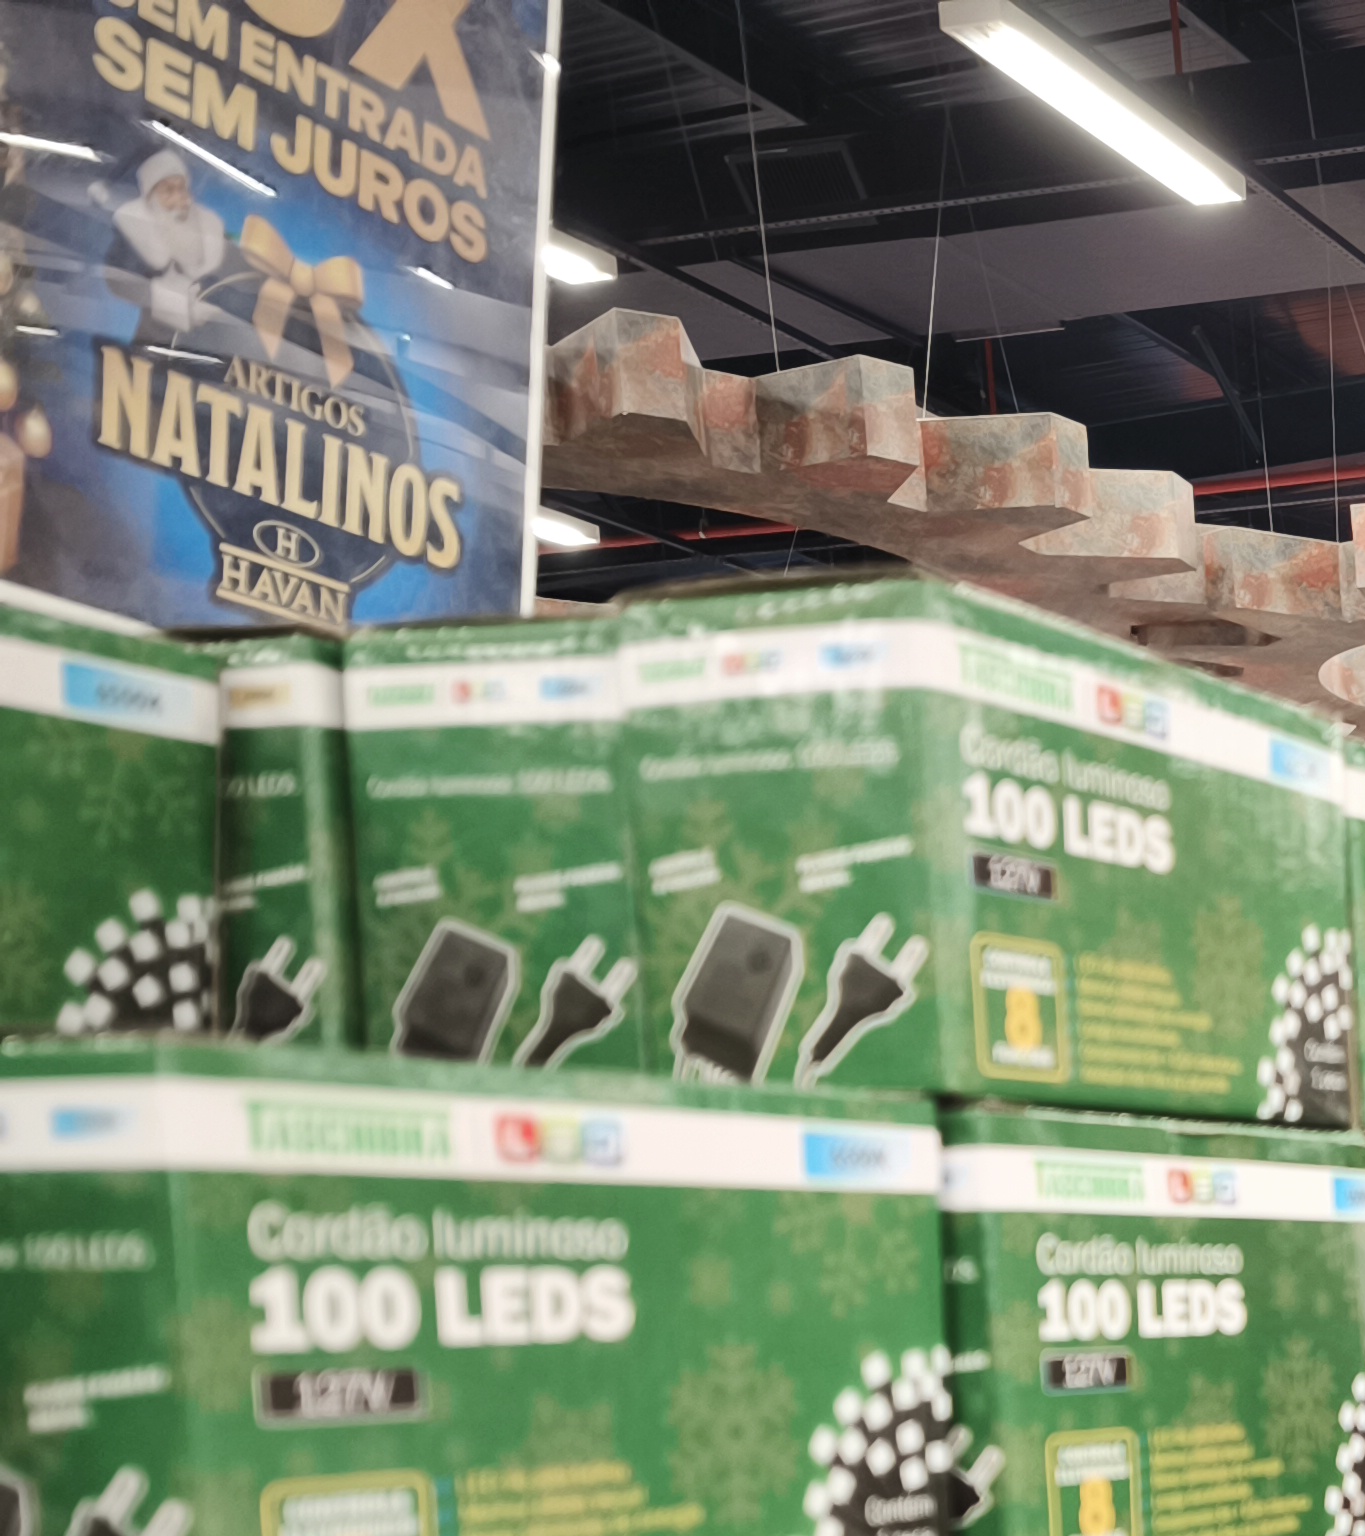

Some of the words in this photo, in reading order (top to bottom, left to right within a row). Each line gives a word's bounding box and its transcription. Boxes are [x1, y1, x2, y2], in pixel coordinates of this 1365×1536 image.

[92, 16, 258, 151] SEM
[270, 113, 489, 264] JUROS
[108, 0, 230, 60] EM
[239, 21, 488, 199] ENTRADA
[224, 354, 366, 438] ARTIGOS
[98, 347, 462, 569] NATALINOS
[221, 549, 347, 626] HAVAN
[961, 771, 1058, 850] 100
[1063, 796, 1175, 874] LEDS
[247, 1200, 429, 1262] Cordão
[432, 1206, 631, 1262] luminoso
[1036, 1231, 1134, 1276] Cordão
[1135, 1236, 1245, 1276] luminoso
[248, 1265, 423, 1355] 100
[434, 1264, 637, 1348] LEDS
[1037, 1277, 1133, 1342] 100
[1135, 1277, 1248, 1339] LEDS
